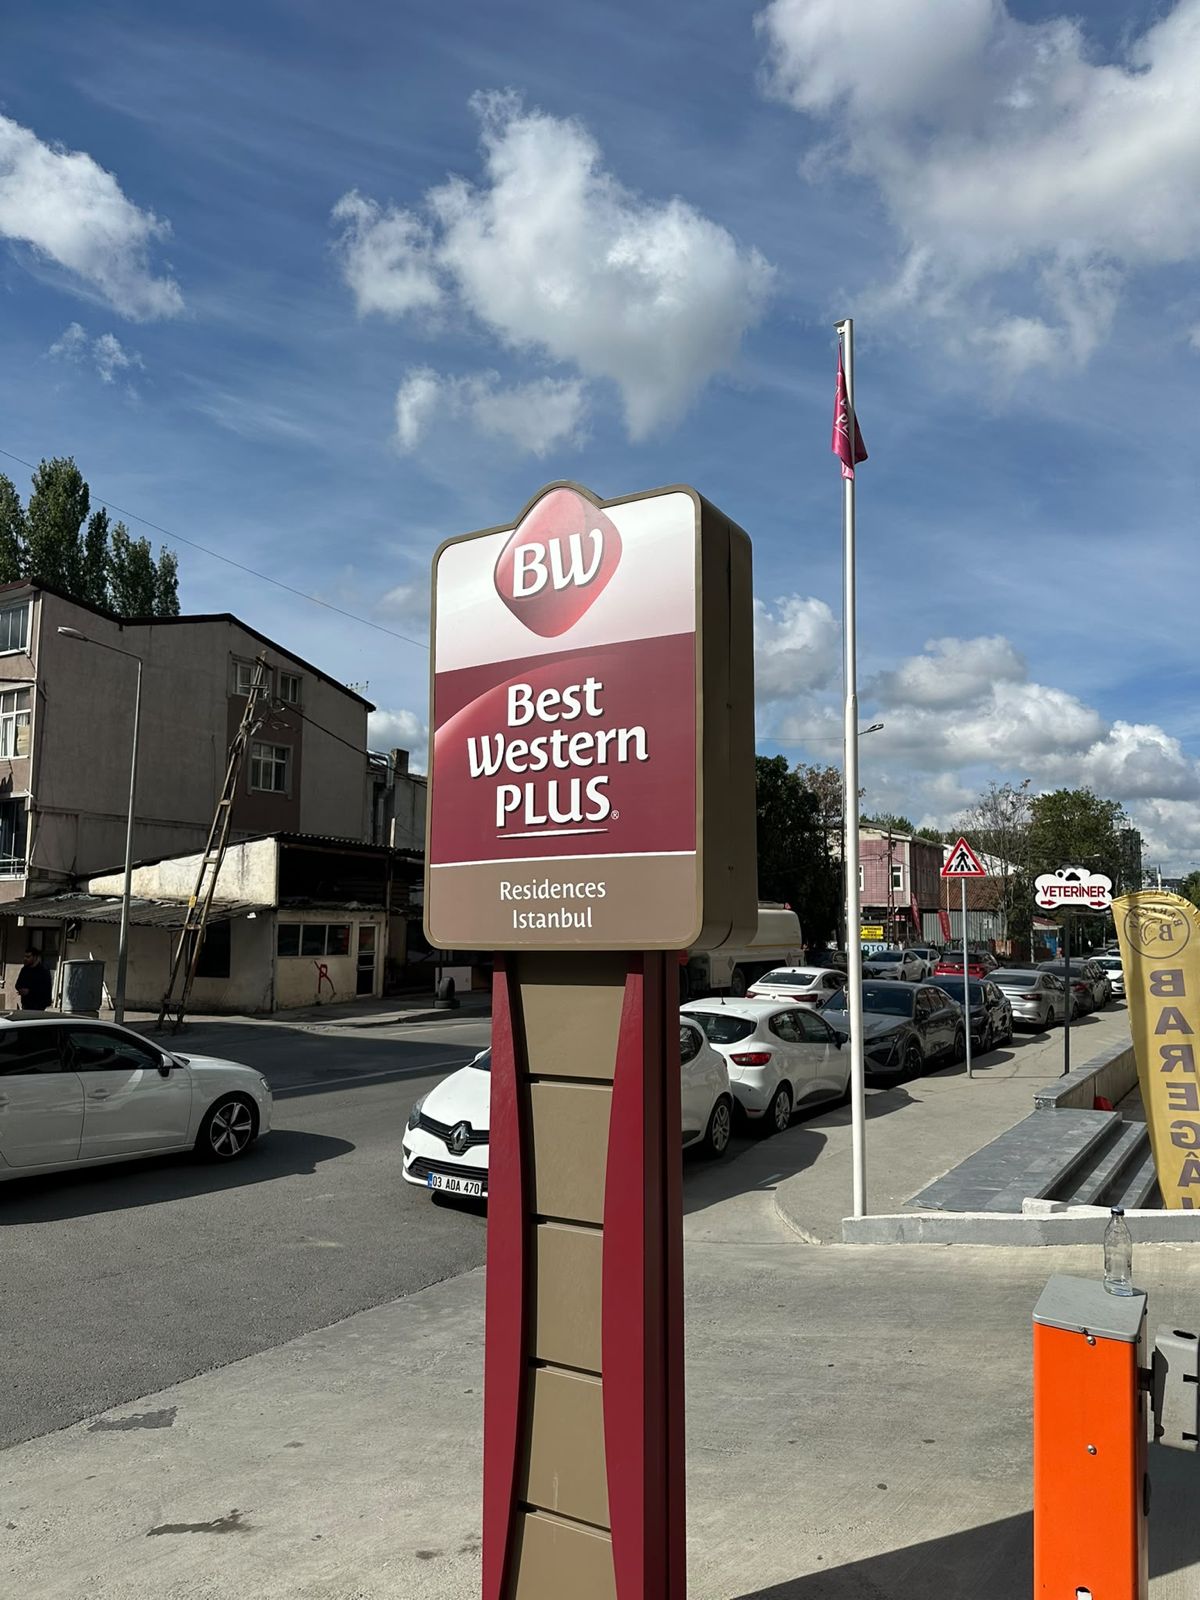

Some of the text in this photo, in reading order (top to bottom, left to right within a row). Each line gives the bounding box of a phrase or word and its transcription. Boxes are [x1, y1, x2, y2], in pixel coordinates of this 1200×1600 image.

[513, 528, 603, 598] BW
[508, 677, 603, 726] Best
[467, 726, 649, 777] Western
[496, 776, 610, 827] PLUS
[500, 879, 606, 900] Residences
[1041, 883, 1106, 897] VETERİNER
[513, 907, 592, 928] Istanbul
[432, 1176, 442, 1187] 03
[464, 1182, 480, 1194] 470
